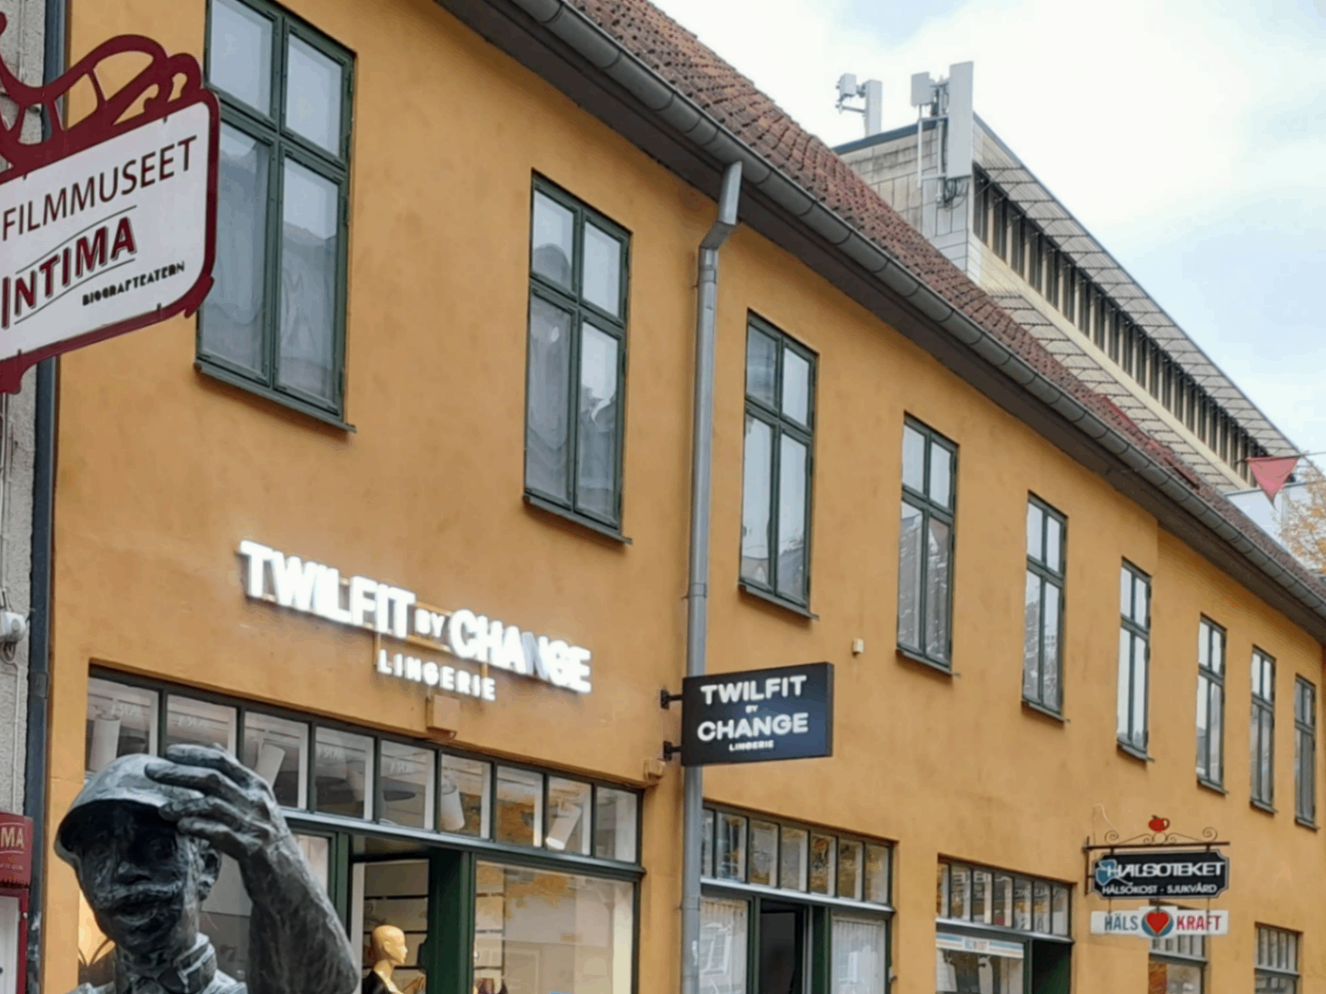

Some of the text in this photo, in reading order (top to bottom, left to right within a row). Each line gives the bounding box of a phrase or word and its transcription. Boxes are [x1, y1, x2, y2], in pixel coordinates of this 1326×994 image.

[2, 135, 197, 241] FILMMUSEET
[1, 216, 137, 330] INTIMA
[82, 260, 185, 306] BIOGRAFTEATERN
[238, 539, 592, 694] TWILFIT BY CHANGE
[377, 648, 496, 702] LINGERIE
[700, 675, 807, 705] TWILFIT
[745, 705, 758, 714] BY
[697, 712, 809, 742] CHANGE
[729, 740, 775, 751] LINGERIE
[1167, 882, 1217, 894] SJUKVÅRD
[1104, 913, 1222, 931] HÄLS KRAFT
